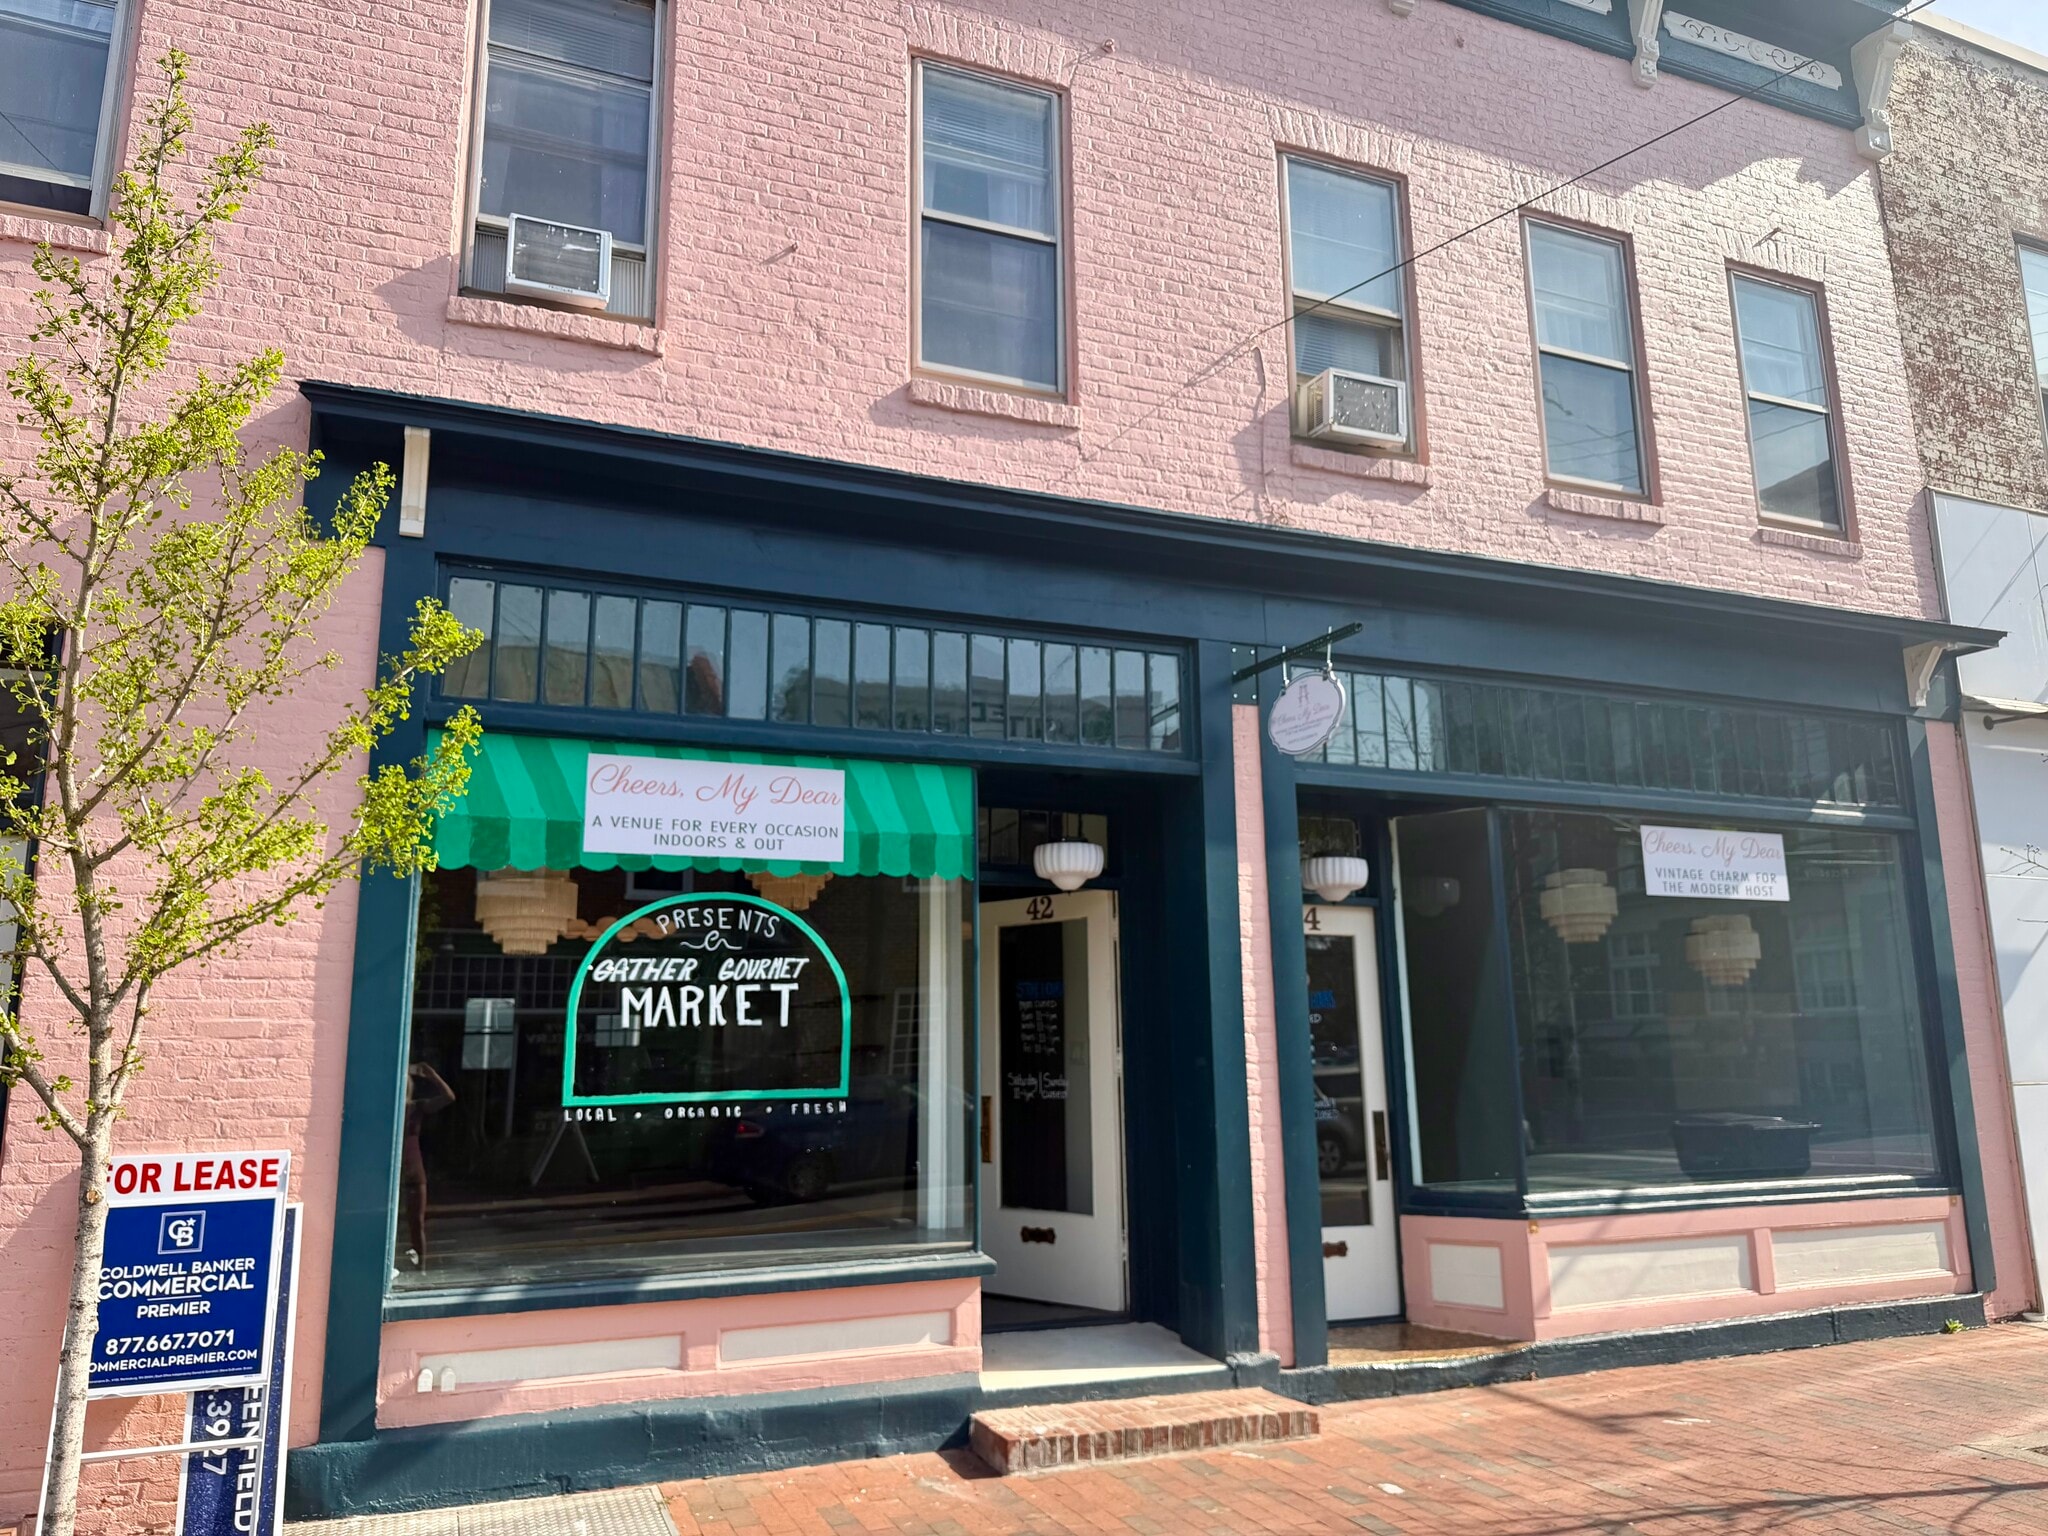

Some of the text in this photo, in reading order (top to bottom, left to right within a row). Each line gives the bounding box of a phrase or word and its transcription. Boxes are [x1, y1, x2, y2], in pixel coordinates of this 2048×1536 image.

[589, 763, 842, 815] Cheers, My Dear
[592, 815, 839, 839] A VENUE FOR EVERY OCCASION
[653, 834, 786, 851] INDOORS & OUT
[1701, 834, 1737, 867] My
[1740, 836, 1784, 860] Dear
[1655, 867, 1778, 884] VINTAGE CHARM FOR
[1662, 880, 1774, 897] THE MODERN HOST
[1026, 896, 1054, 921] 42
[656, 907, 780, 939] PRESENTS
[591, 957, 810, 983] GATHER GOURMET
[621, 982, 800, 1029] MARKET
[564, 1107, 618, 1123] LOCAL
[791, 1101, 848, 1116] FRESH
[173, 1158, 280, 1192] LEASE
[100, 1257, 256, 1281] COLDWELL BANKER
[98, 1272, 255, 1300] COMMERCIAL
[136, 1301, 211, 1319] PREMIER
[105, 1329, 235, 1356] 877.667.7071
[89, 1349, 258, 1374] OMMERCIALPREMIER.COM
